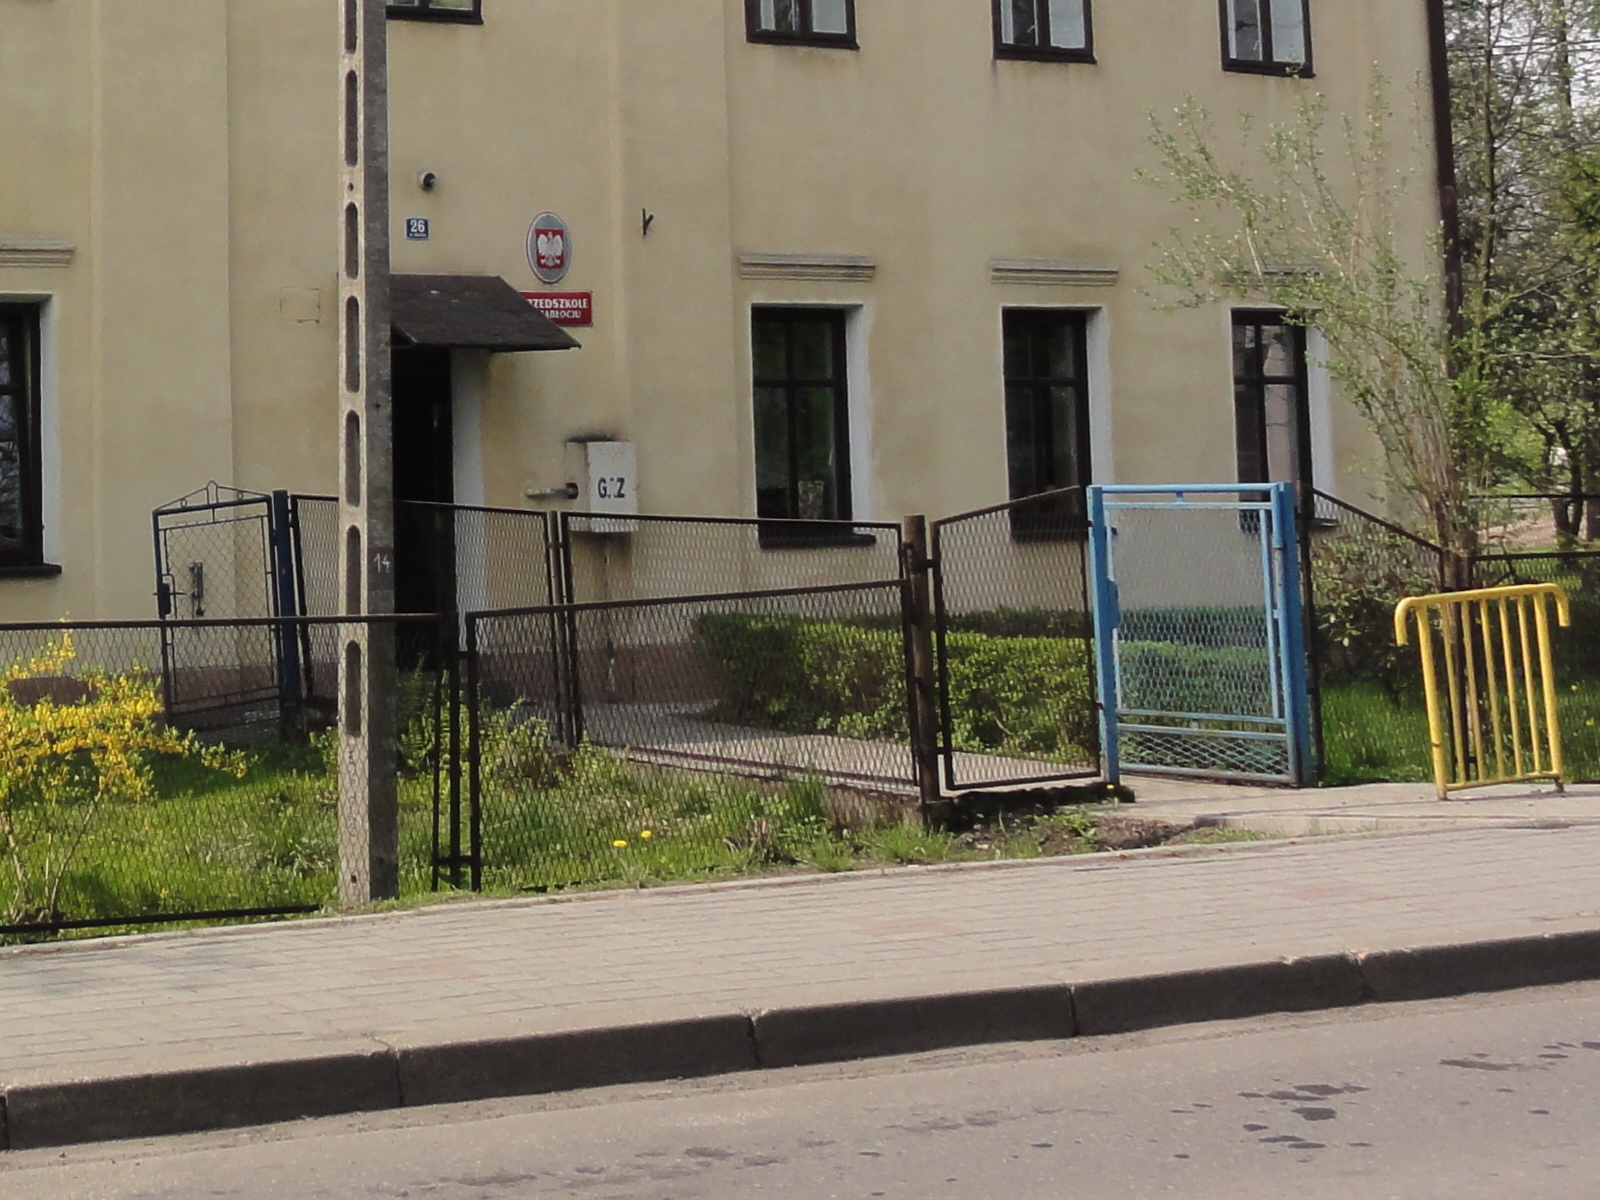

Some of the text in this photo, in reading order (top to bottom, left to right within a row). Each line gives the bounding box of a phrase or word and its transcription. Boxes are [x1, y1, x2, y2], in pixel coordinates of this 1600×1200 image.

[410, 219, 425, 233] 26
[527, 298, 588, 309] ZEDSZKOLE
[540, 309, 581, 319] ABŁOCIU
[597, 476, 626, 499] GZ
[373, 553, 390, 573] 14
